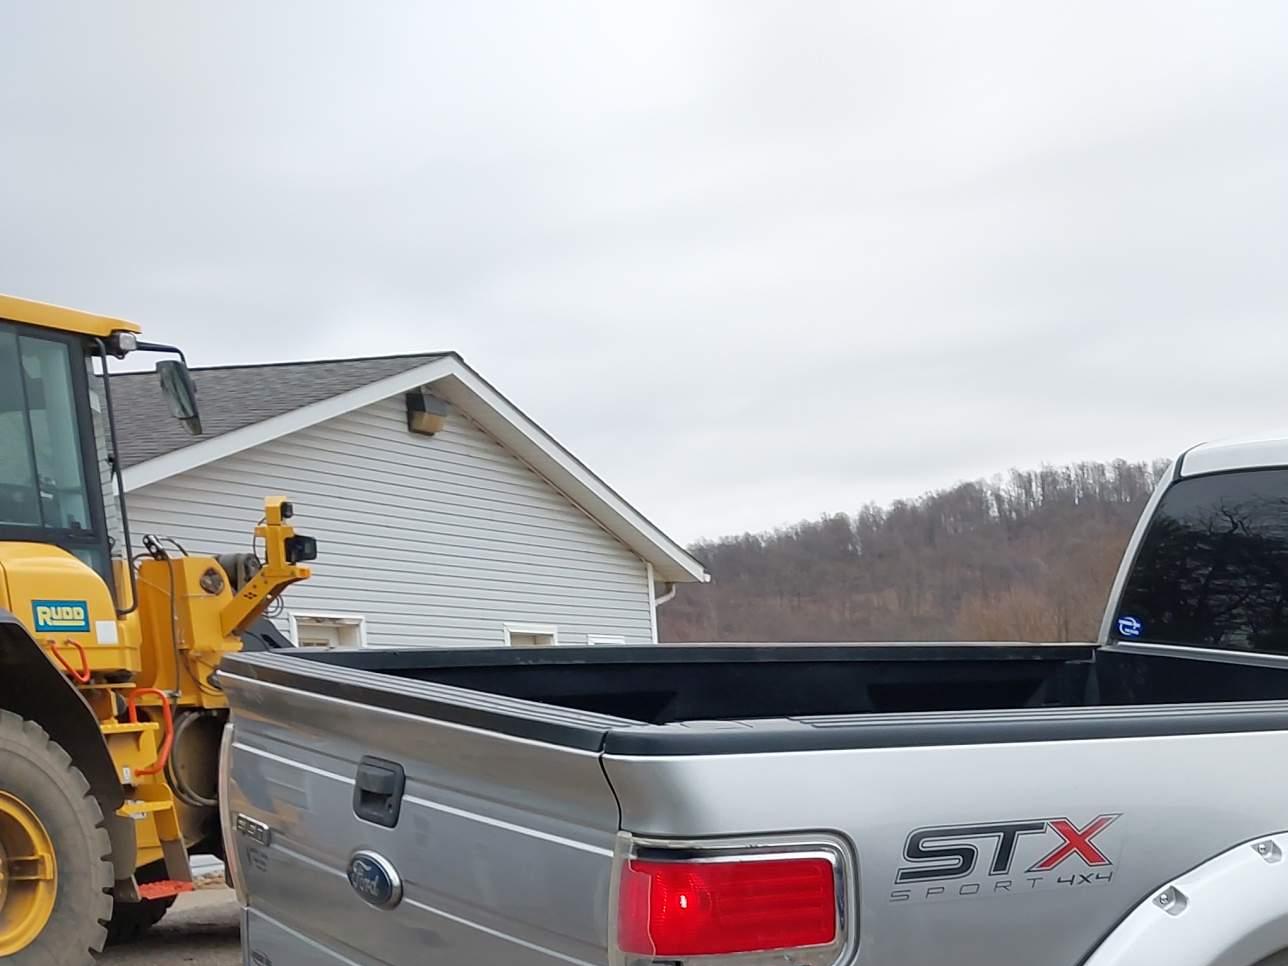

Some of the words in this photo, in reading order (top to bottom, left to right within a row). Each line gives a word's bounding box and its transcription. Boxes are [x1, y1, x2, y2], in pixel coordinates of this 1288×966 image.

[36, 606, 85, 626] RUDD
[894, 812, 1124, 885] STX
[890, 876, 1044, 903] SPORT
